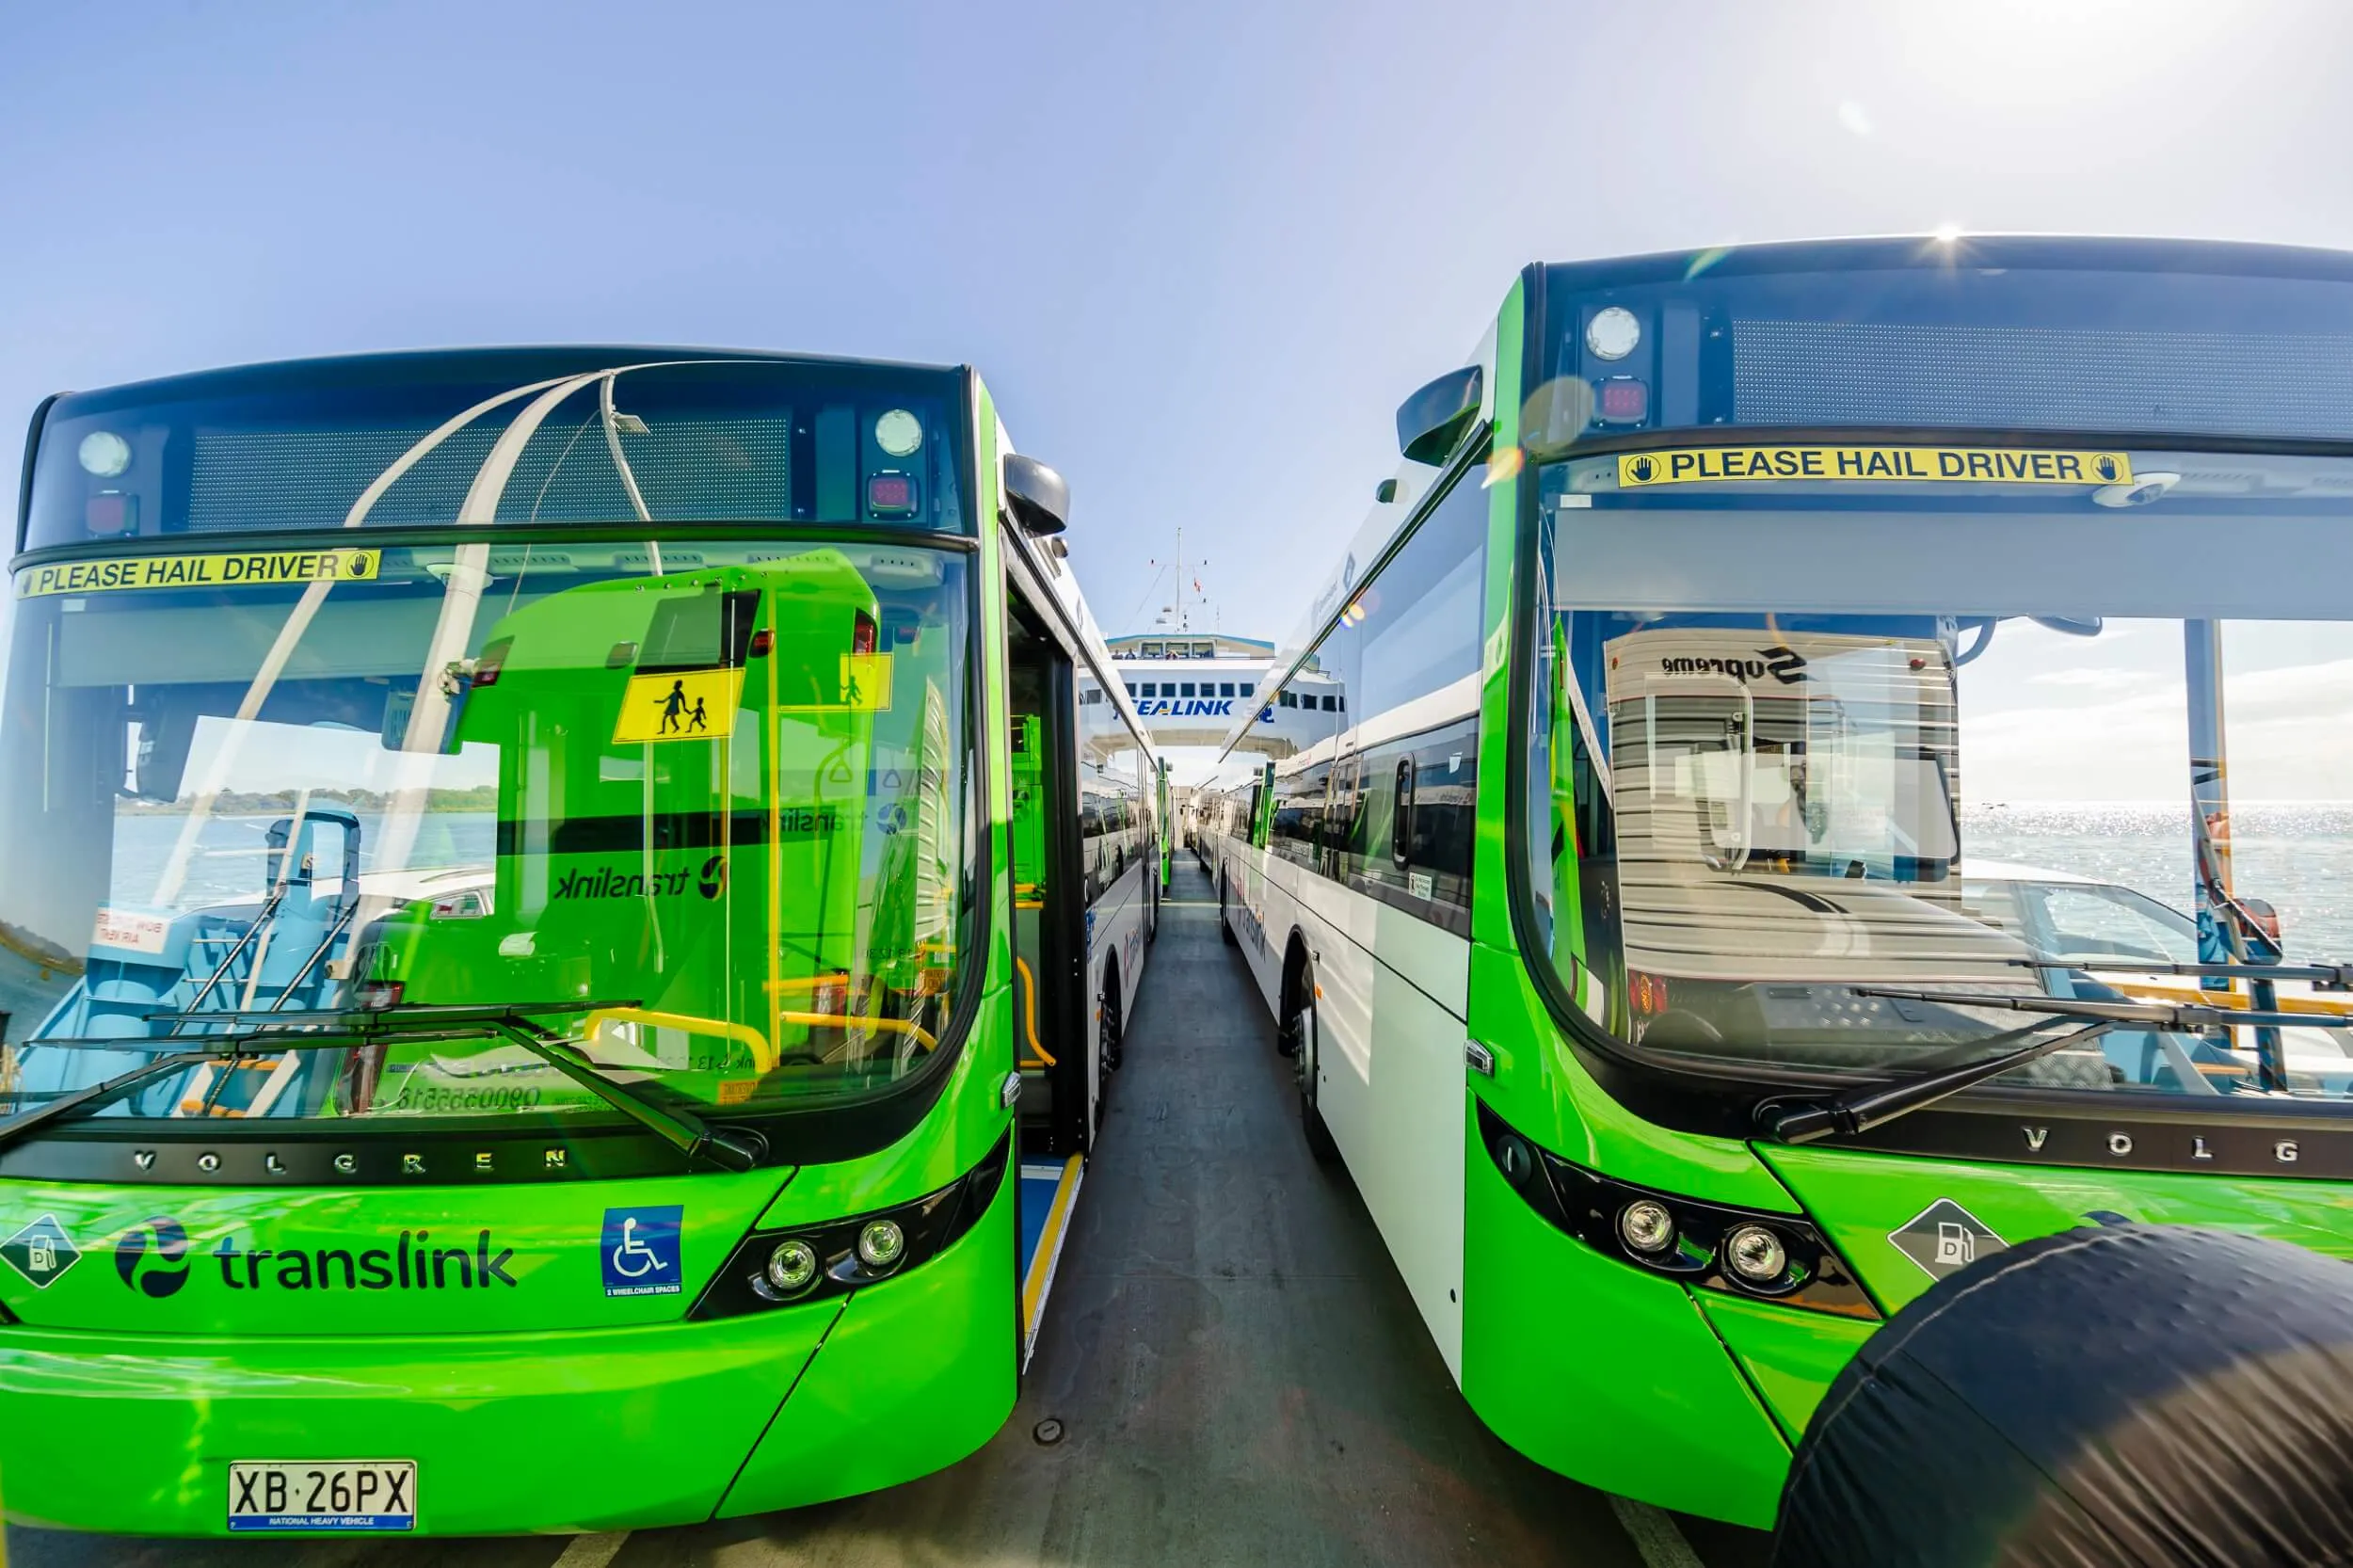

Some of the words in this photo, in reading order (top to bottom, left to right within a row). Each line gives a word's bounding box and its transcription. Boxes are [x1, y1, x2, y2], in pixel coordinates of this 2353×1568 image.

[1671, 450, 1825, 479] PLEASE
[1837, 451, 1928, 477] HAIL
[1939, 452, 2084, 480] DRIVER
[39, 562, 136, 593] PLEASE
[145, 560, 214, 585] HAIL
[222, 553, 338, 581] DRIVER
[134, 1148, 567, 1175] VOLGREN
[213, 1228, 518, 1289] translink
[613, 1287, 654, 1296] WHEELCHAIR
[655, 1285, 680, 1294] SPACES
[268, 1516, 310, 1526] NATIONAL
[310, 1516, 340, 1526] HEAVY
[340, 1516, 375, 1526] VEHICLE
